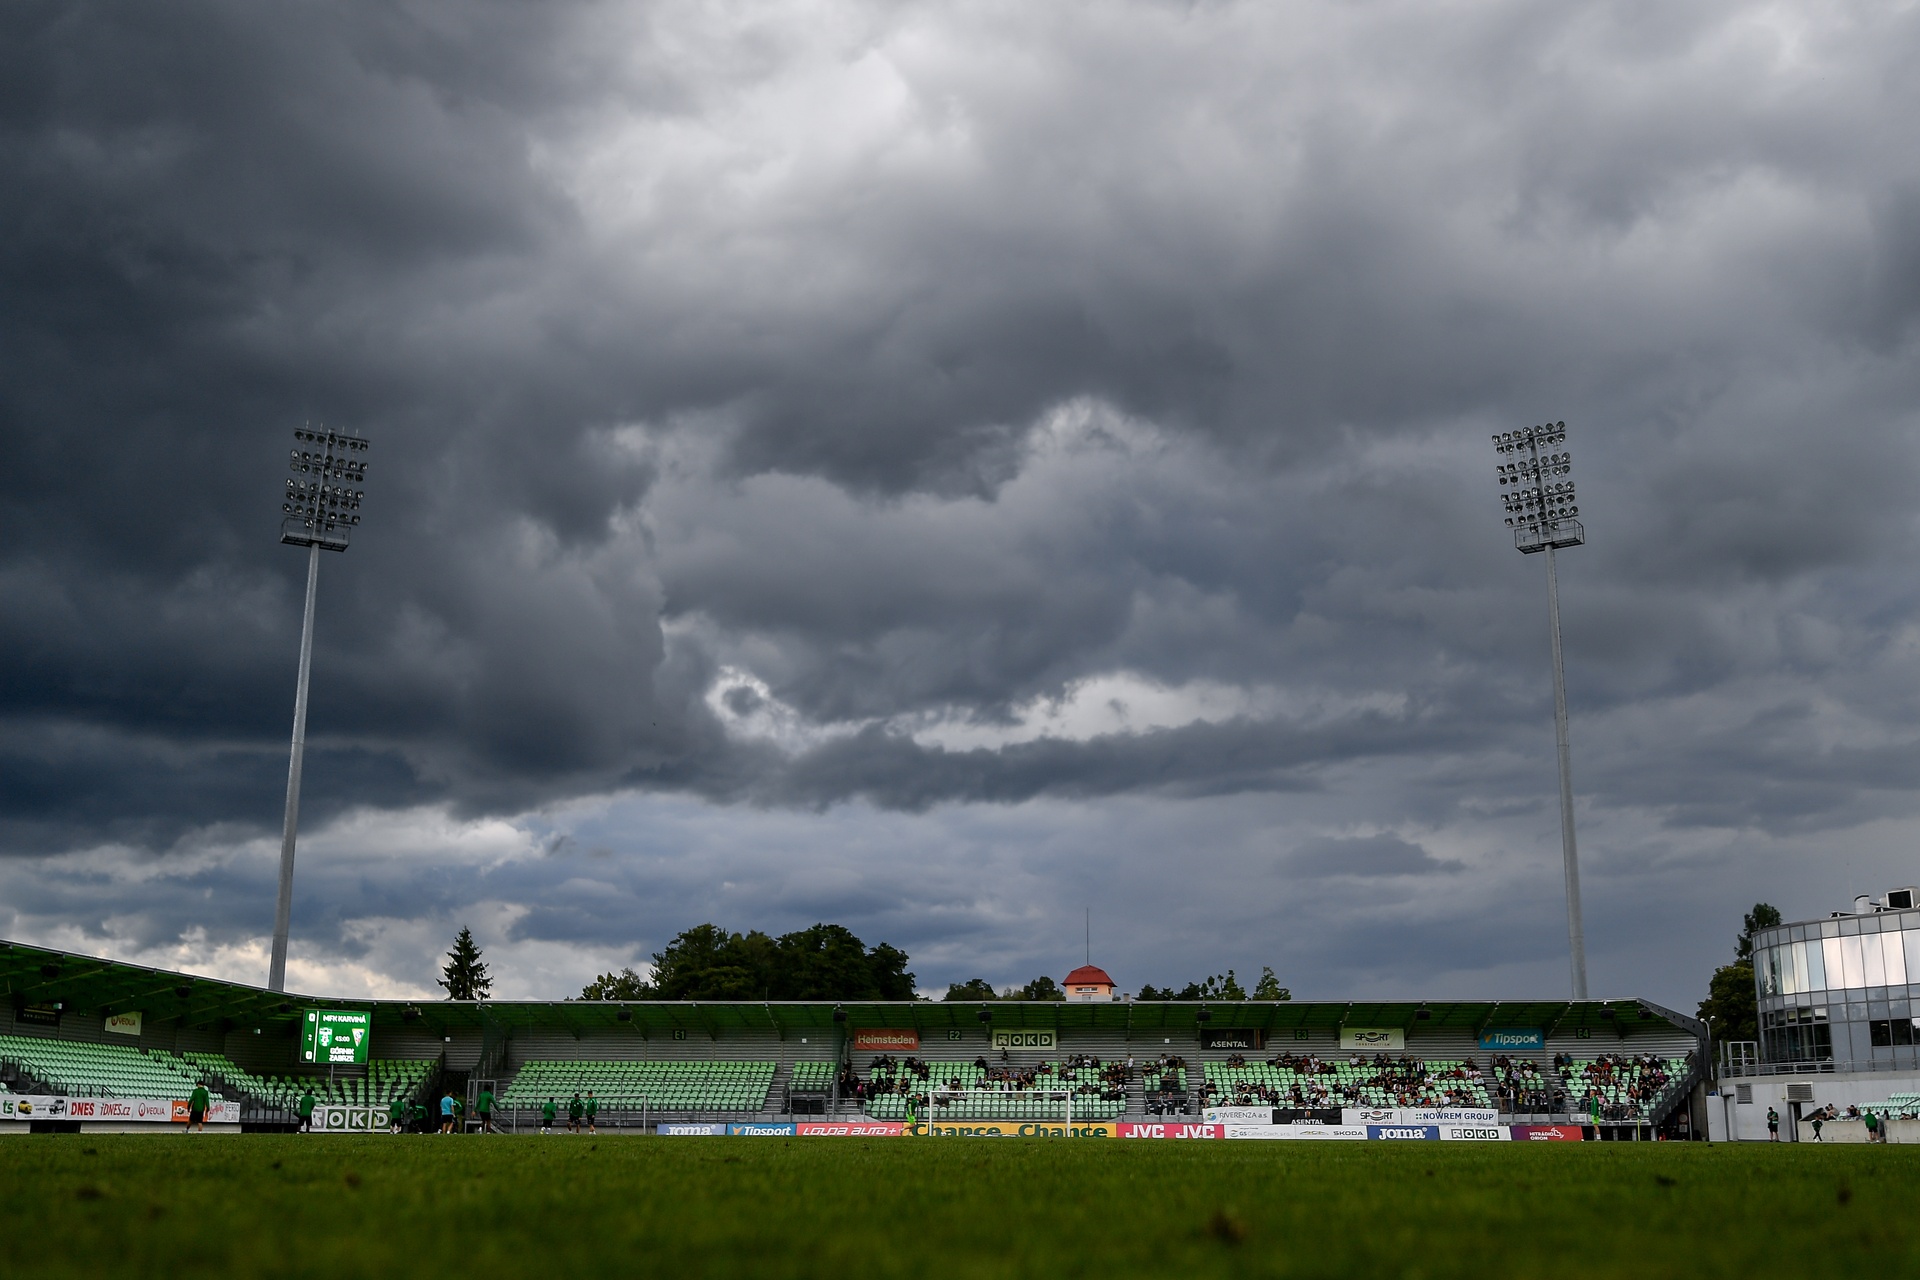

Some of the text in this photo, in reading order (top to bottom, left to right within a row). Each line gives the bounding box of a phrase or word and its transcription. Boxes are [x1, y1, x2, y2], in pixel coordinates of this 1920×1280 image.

[674, 1030, 686, 1040] E1
[950, 1030, 961, 1040] E2
[1296, 1030, 1308, 1040] E3
[1577, 1028, 1589, 1038] E4
[857, 1034, 915, 1046] Heimstaden
[1210, 1040, 1248, 1048] ASENTAL
[1495, 1033, 1539, 1046] Tipsport
[71, 1102, 95, 1116] DNES
[100, 1103, 131, 1117] iDNES.cz
[146, 1107, 165, 1115] VEOLIA
[1423, 1112, 1495, 1121] NOWREM GROUP
[1018, 1124, 1108, 1137] Chance
[1125, 1125, 1215, 1138] JVC JVC
